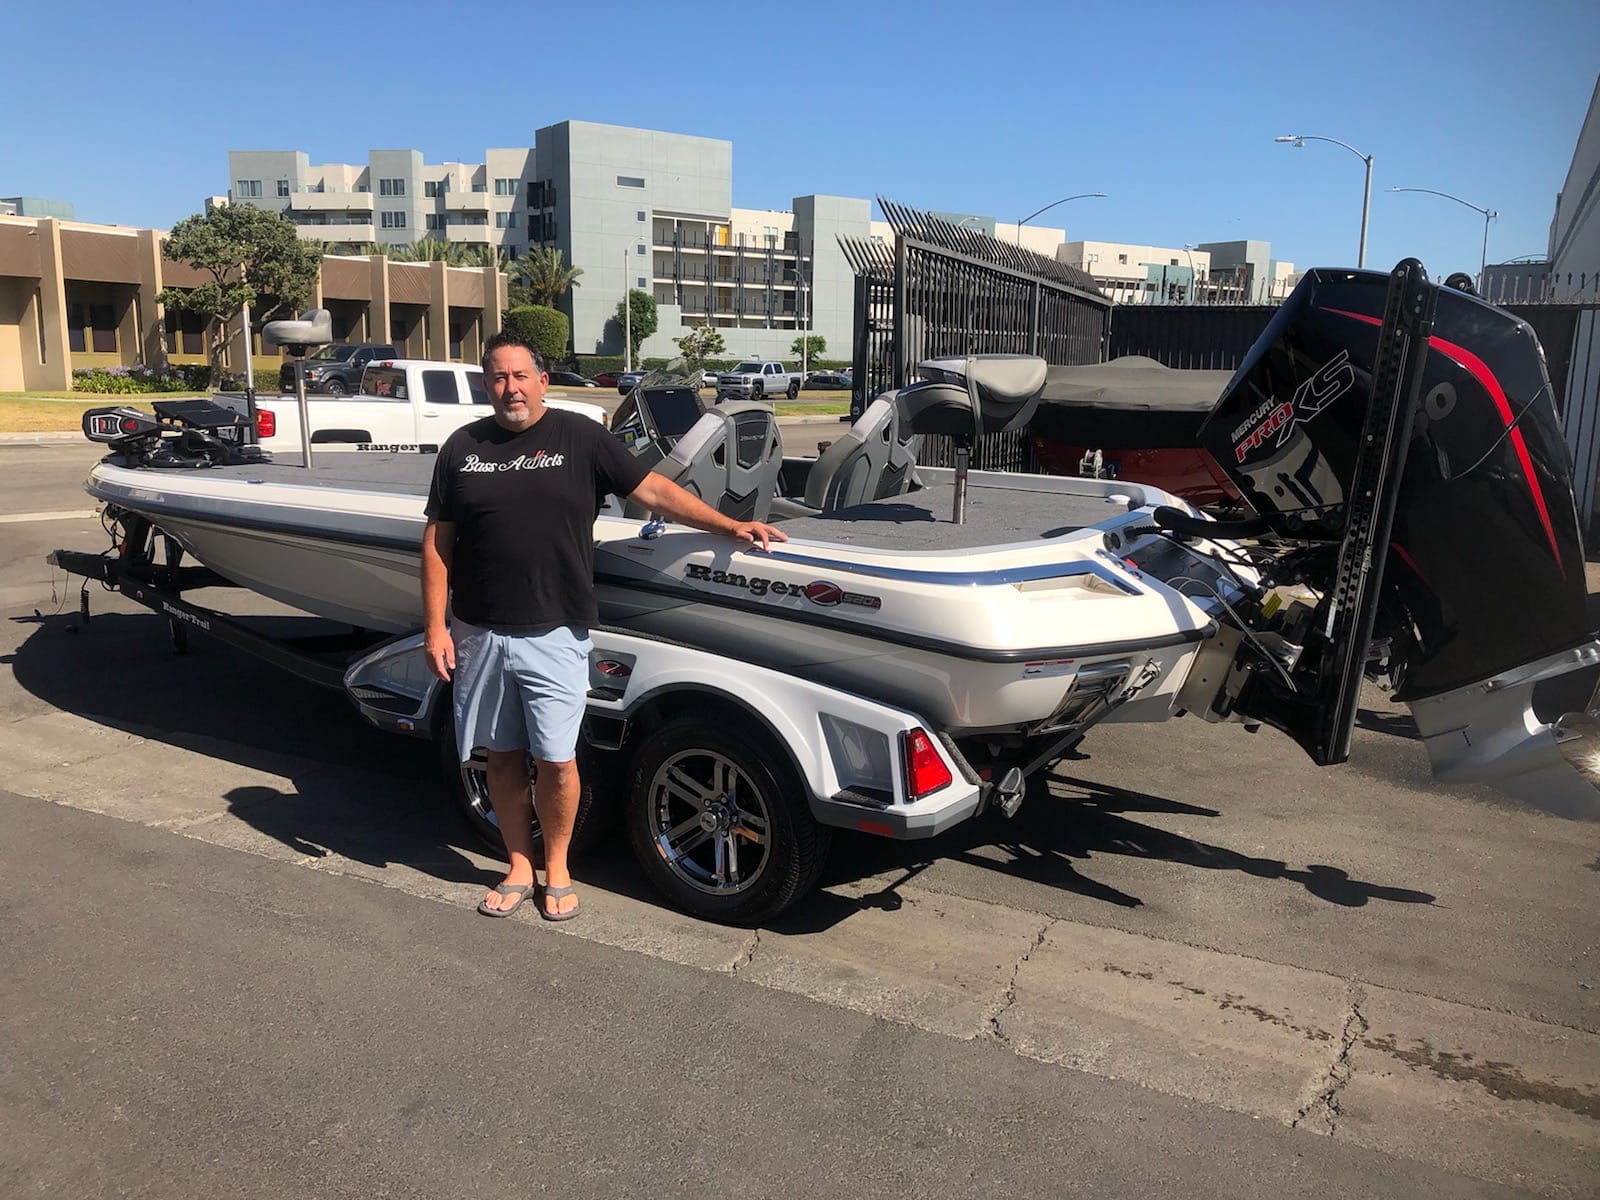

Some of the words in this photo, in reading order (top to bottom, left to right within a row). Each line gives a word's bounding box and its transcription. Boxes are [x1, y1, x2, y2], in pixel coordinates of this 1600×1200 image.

[1230, 395, 1276, 443] MERCURY
[1235, 401, 1294, 463] PRO
[1276, 349, 1355, 448] XS
[357, 444, 418, 453] Ranger
[459, 453, 498, 473] Bass
[498, 450, 565, 472] Addicts
[686, 563, 809, 596] Ranger
